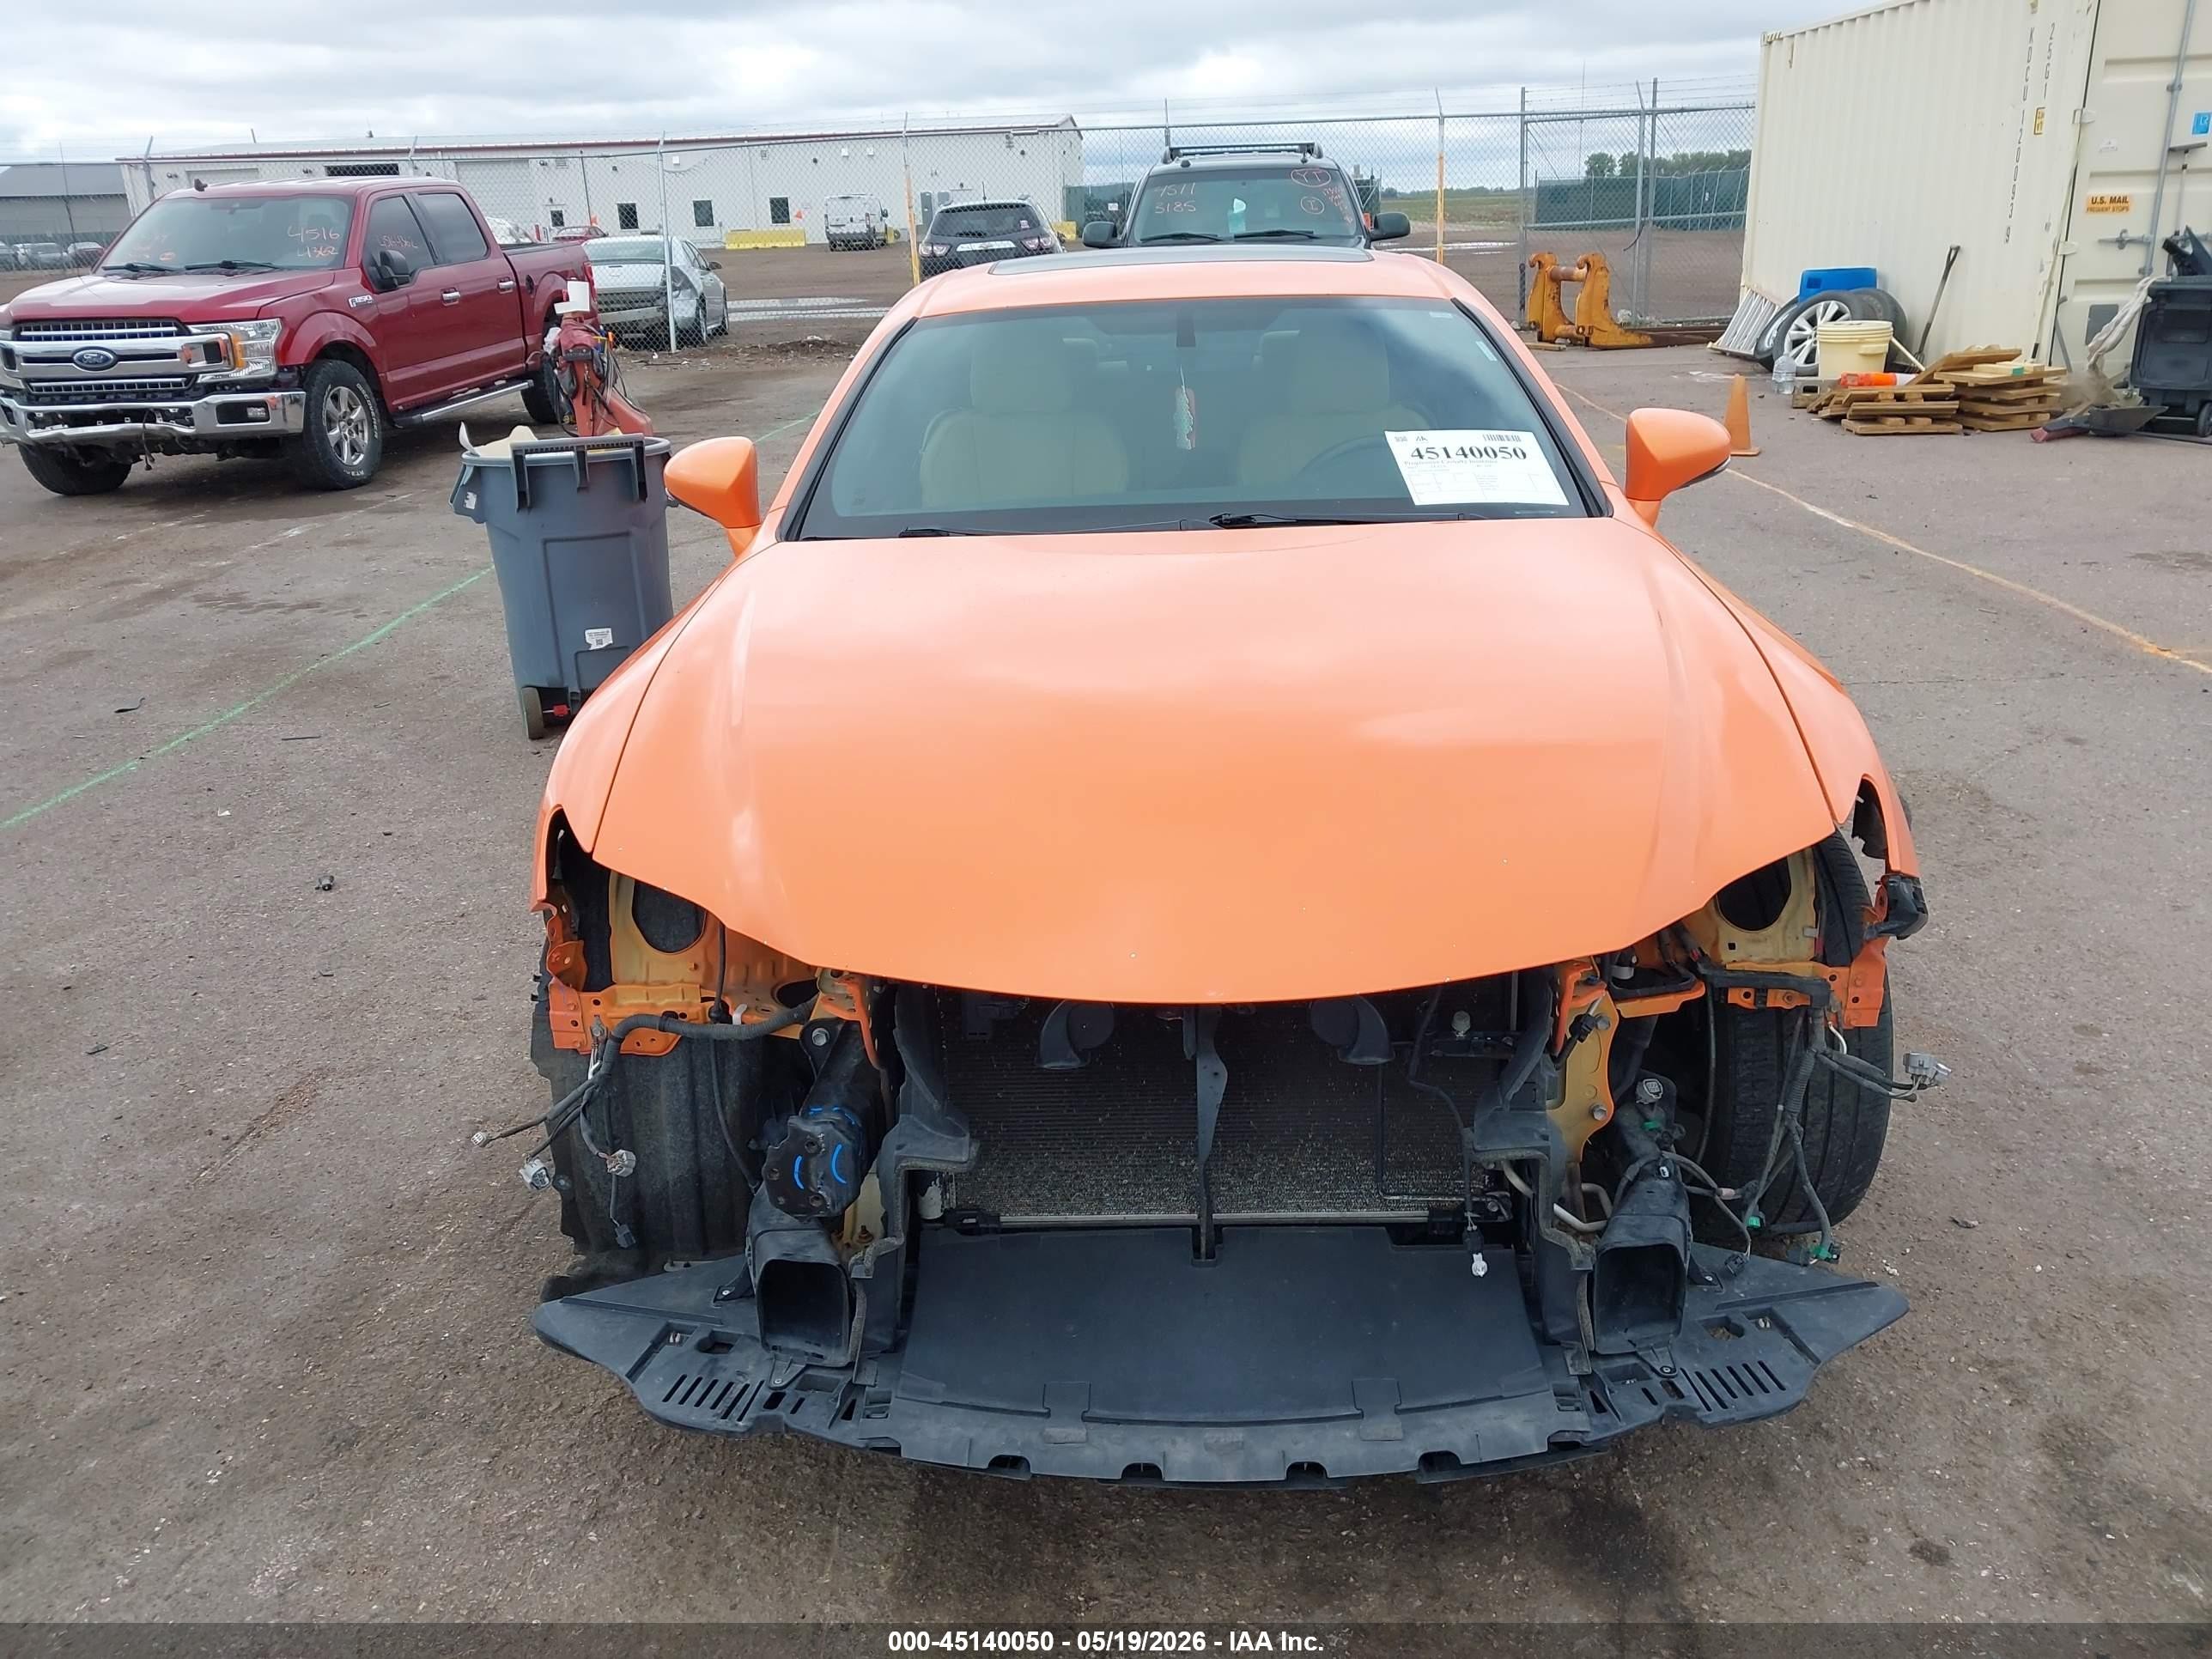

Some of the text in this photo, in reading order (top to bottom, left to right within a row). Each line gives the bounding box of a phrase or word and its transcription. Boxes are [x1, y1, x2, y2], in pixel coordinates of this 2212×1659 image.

[2091, 195, 2130, 205] U.S. MAIL
[287, 225, 341, 243] 4516
[1410, 446, 1527, 460] 45140050
